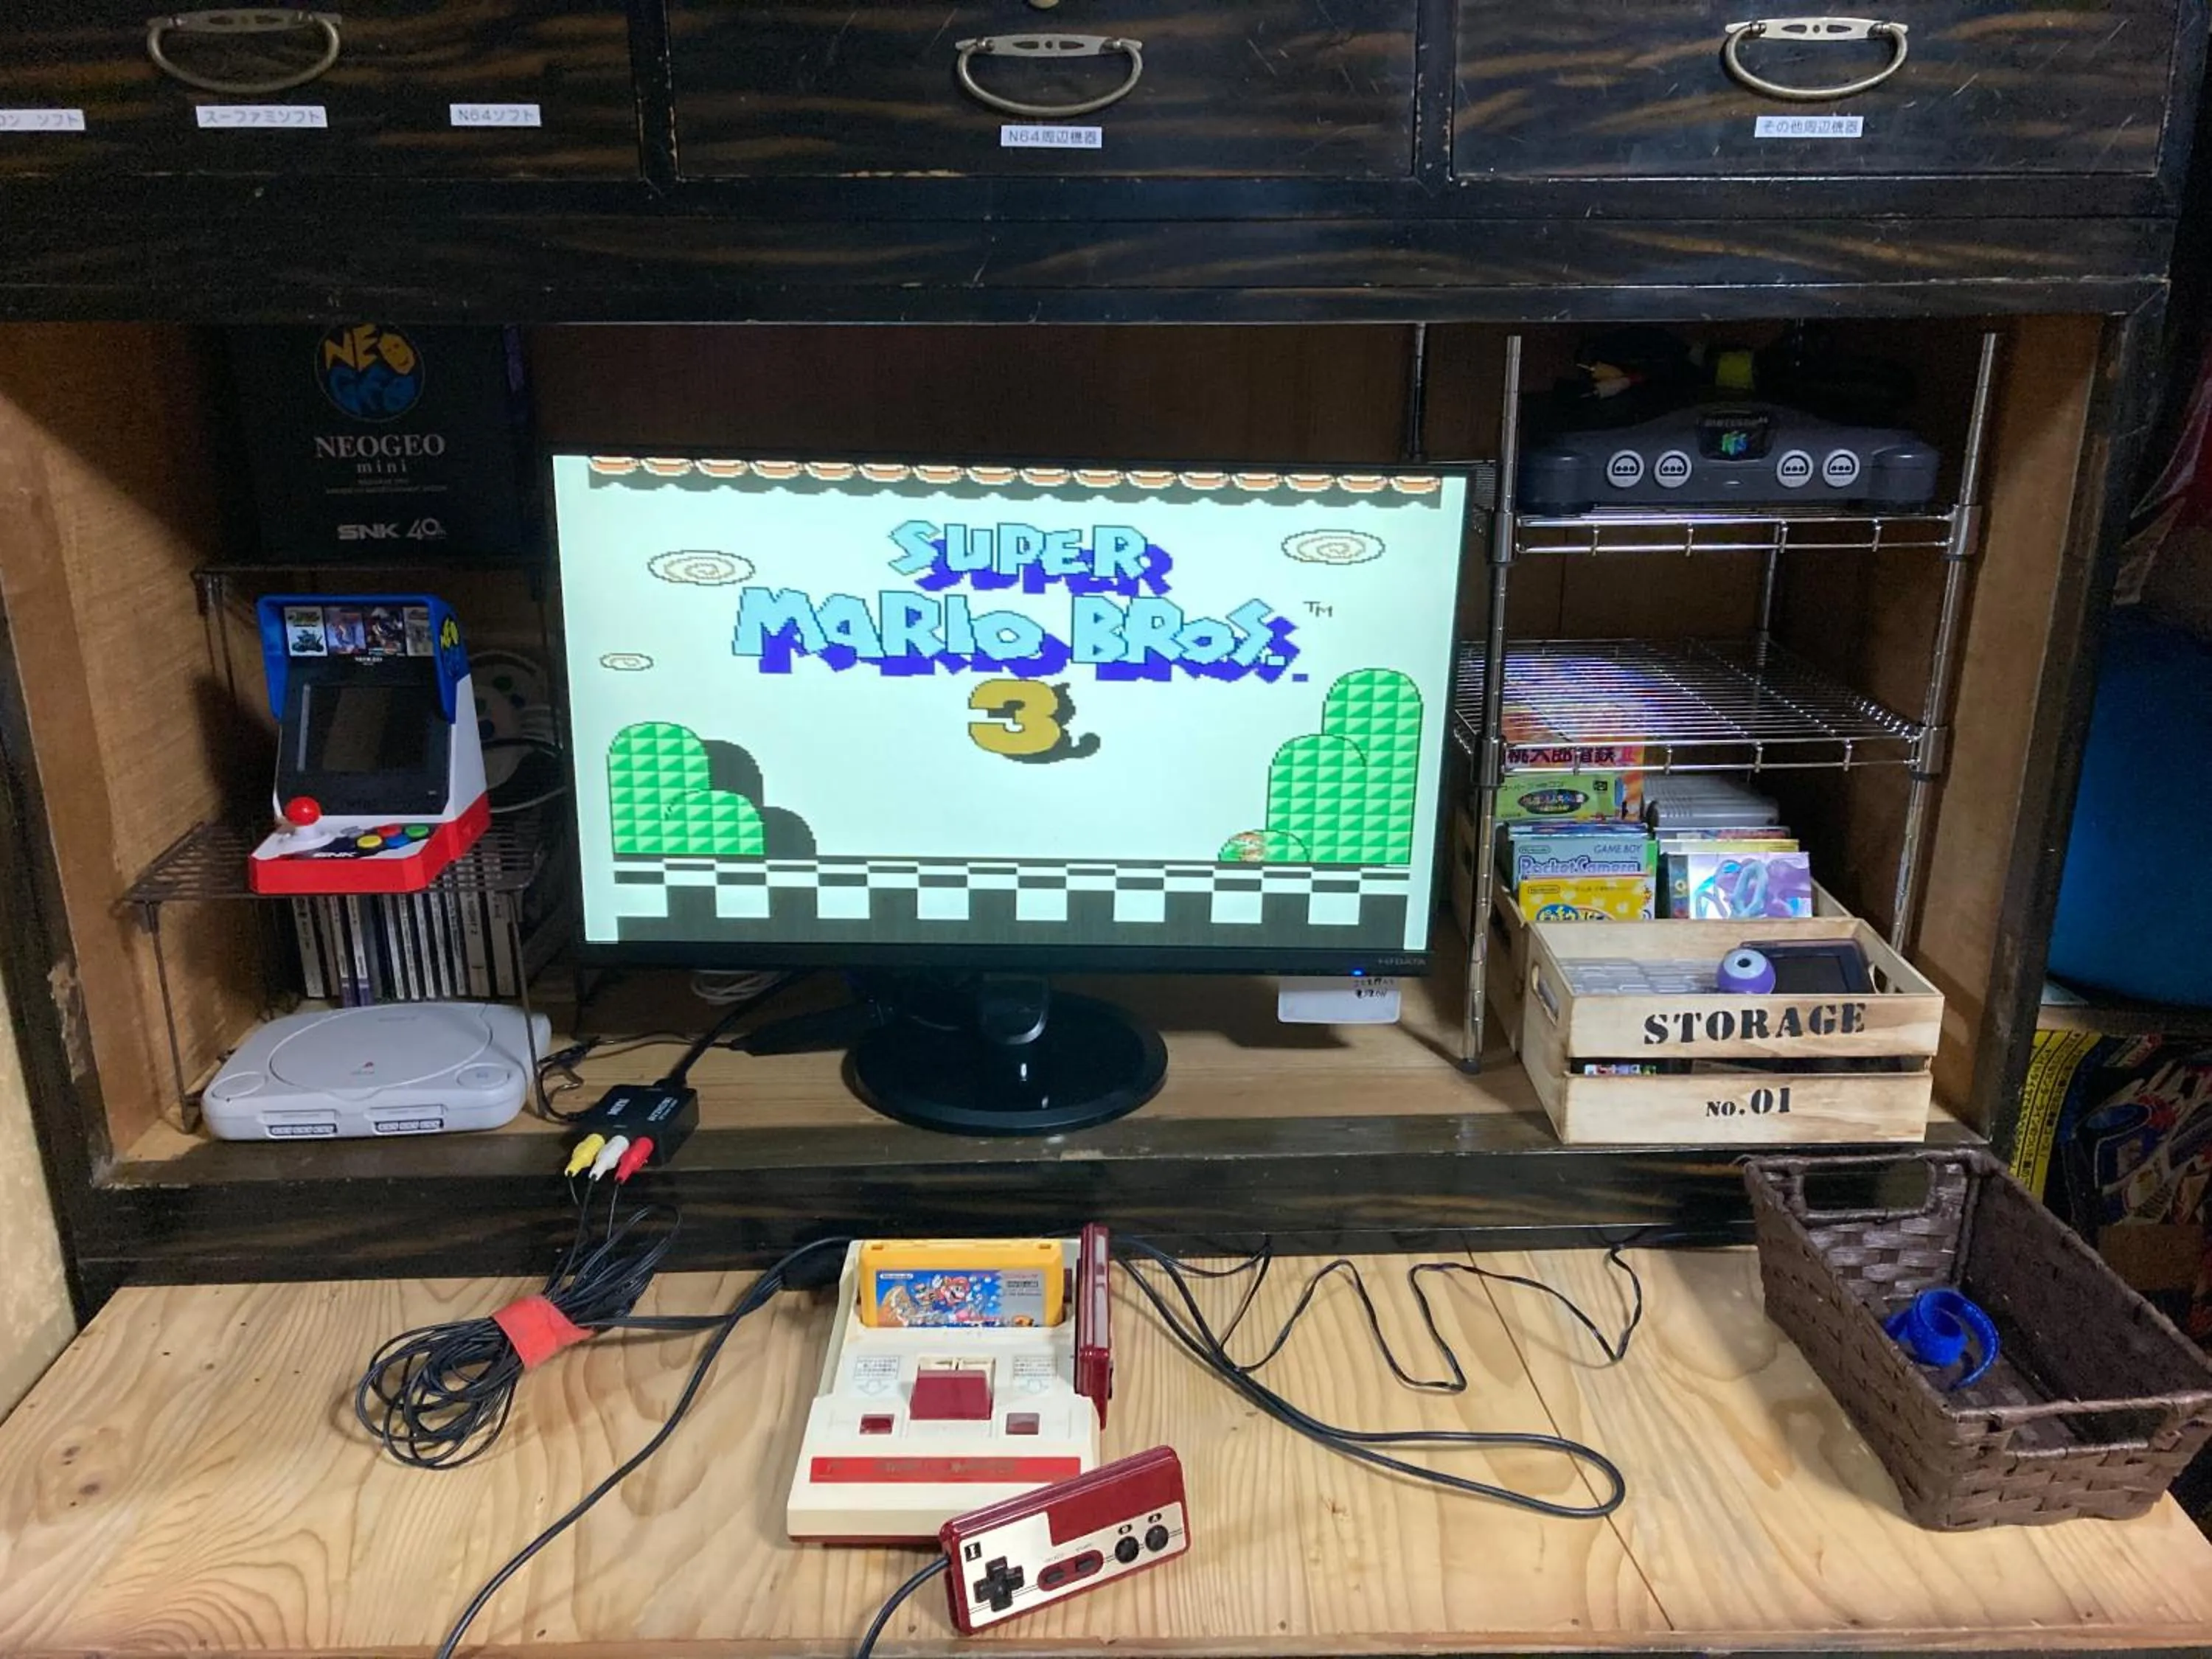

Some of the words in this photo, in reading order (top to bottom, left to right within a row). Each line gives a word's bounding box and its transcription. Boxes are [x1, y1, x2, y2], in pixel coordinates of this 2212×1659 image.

[324, 322, 417, 375] NEO
[313, 434, 446, 459] NEOGEO
[357, 459, 408, 473] mini
[336, 522, 400, 540] SNK
[888, 520, 1168, 590] SUPER
[732, 587, 1054, 669] MARIO
[967, 678, 1069, 757] 3
[1644, 1003, 1867, 1045] STORAGE
